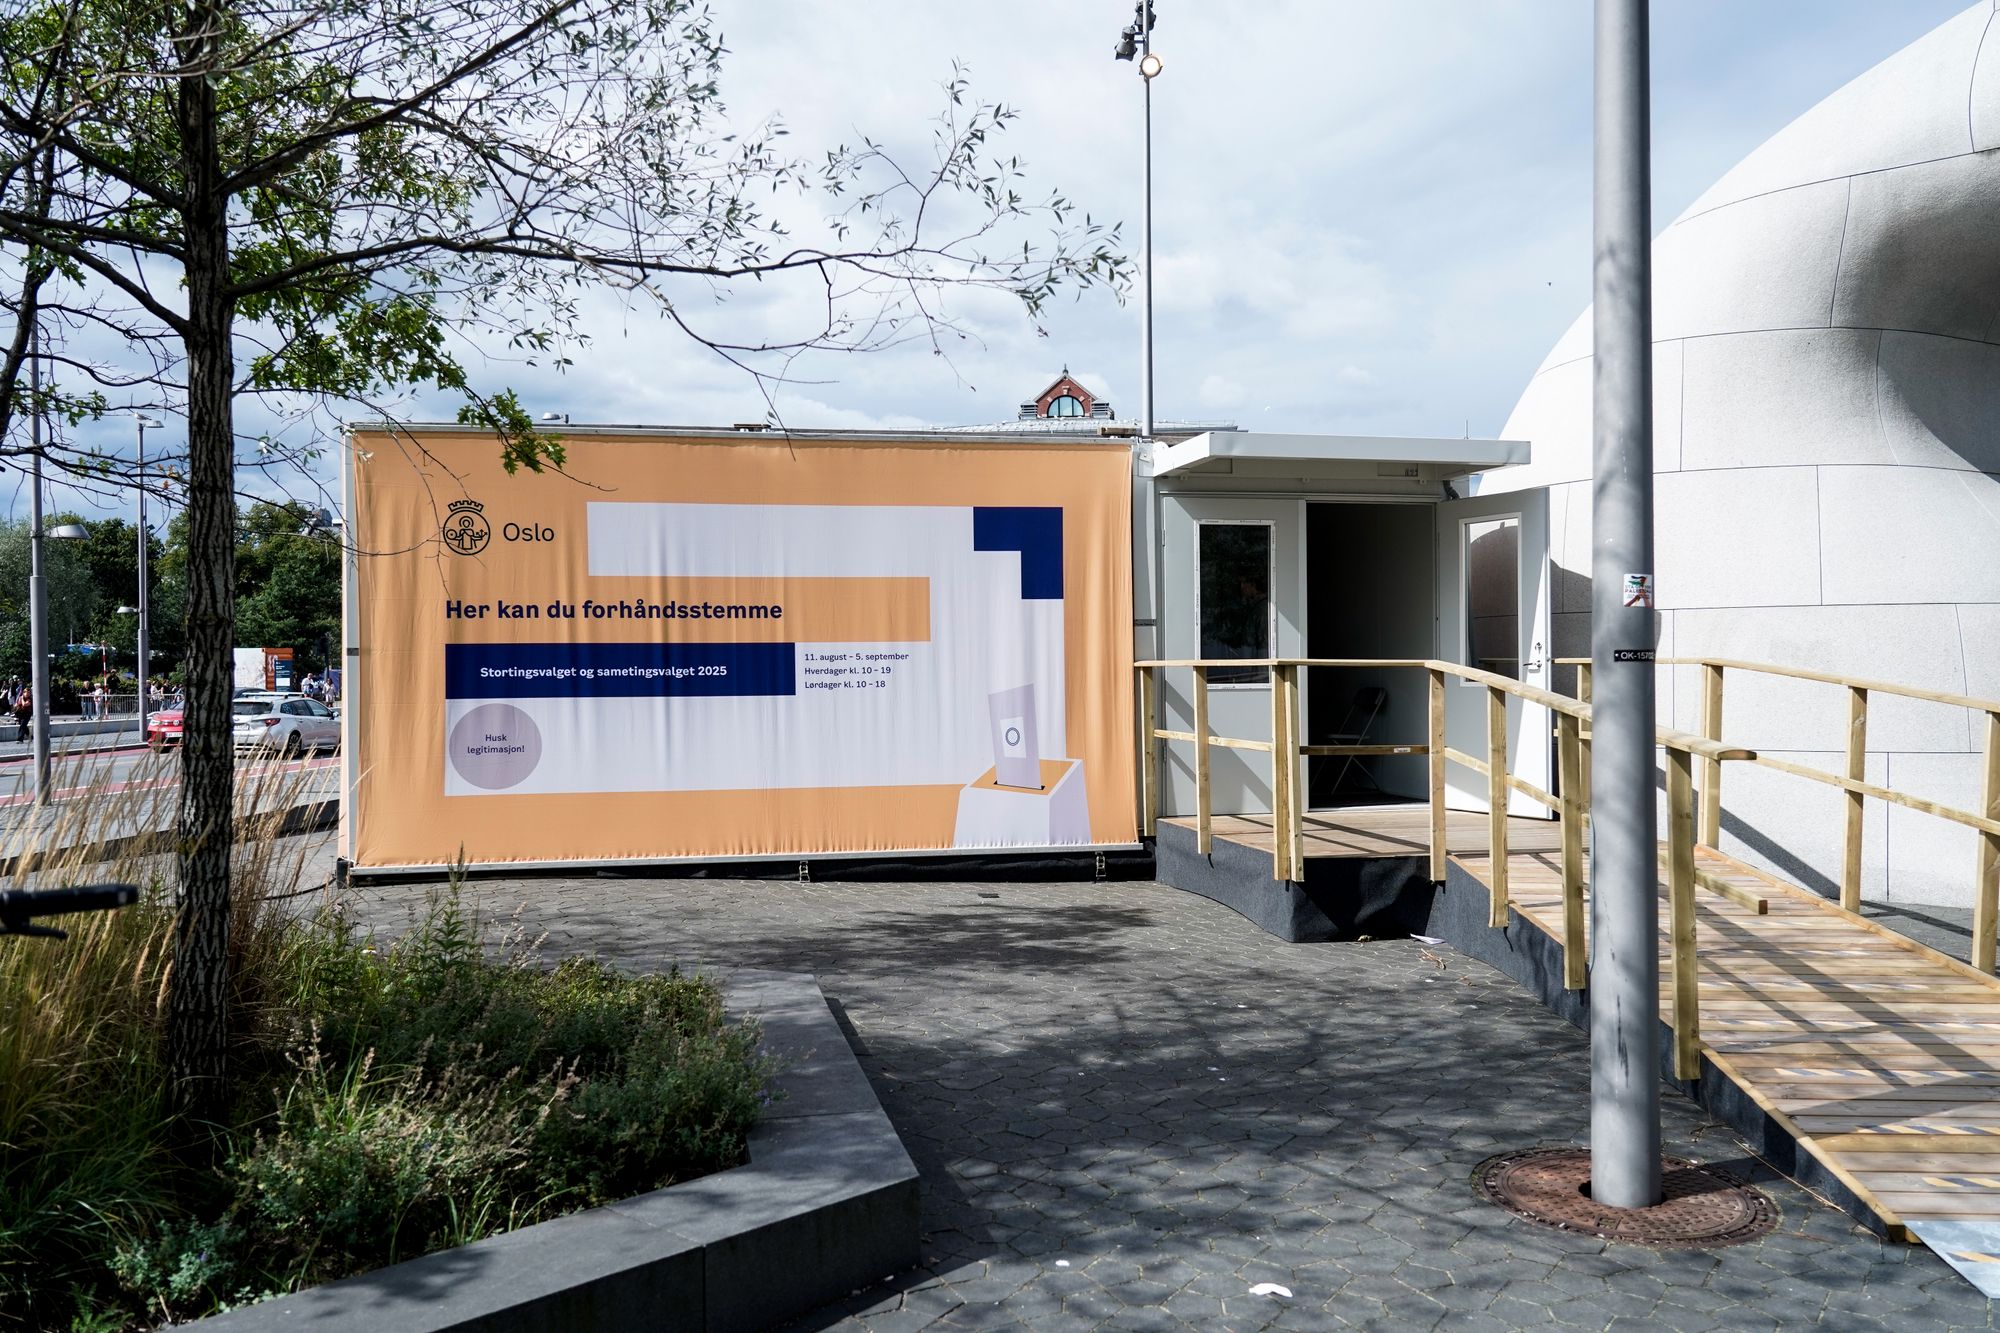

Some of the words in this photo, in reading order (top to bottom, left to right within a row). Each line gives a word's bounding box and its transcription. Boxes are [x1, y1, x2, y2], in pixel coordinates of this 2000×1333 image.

[502, 522, 555, 542] Oslo
[446, 600, 490, 619] Her
[497, 600, 539, 619] kan
[547, 600, 575, 619] du
[582, 598, 783, 619] forhåndsstemme
[804, 653, 818, 661] 11.
[819, 653, 847, 663] august
[855, 653, 864, 661] 5.
[865, 652, 910, 662] september
[480, 667, 577, 680] Stortingsvalget
[579, 669, 595, 679] og
[596, 666, 696, 679] sametingsvalget
[697, 666, 728, 677] 2025
[804, 667, 848, 676] Hverdager
[849, 667, 860, 675] kl.
[861, 666, 873, 675] 10
[880, 666, 892, 674] 19
[804, 681, 842, 690] Lørdager
[843, 681, 854, 689] kl.
[856, 680, 867, 688] 10
[875, 680, 886, 688] 18
[485, 734, 508, 743] Husk
[467, 745, 525, 756] legitimasjon!
